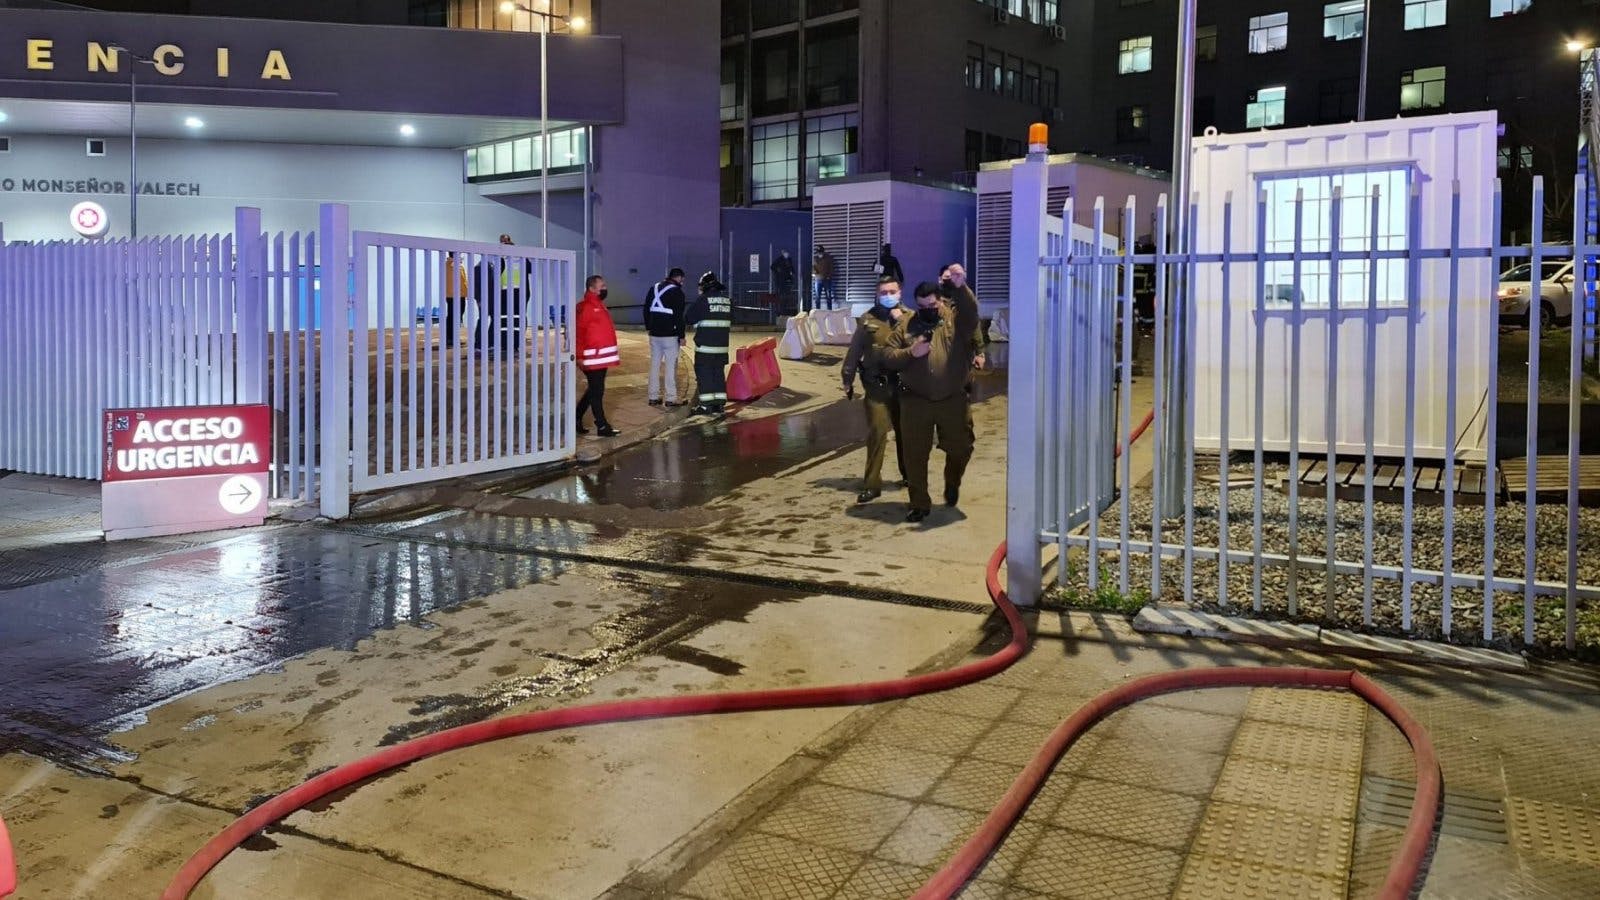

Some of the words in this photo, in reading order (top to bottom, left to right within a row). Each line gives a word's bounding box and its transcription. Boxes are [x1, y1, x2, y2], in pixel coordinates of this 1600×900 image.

[27, 39, 292, 80] ENCIA
[22, 178, 125, 194] MONSEÑOR
[133, 416, 242, 443] ACCESO
[117, 443, 259, 472] URGENCIA
